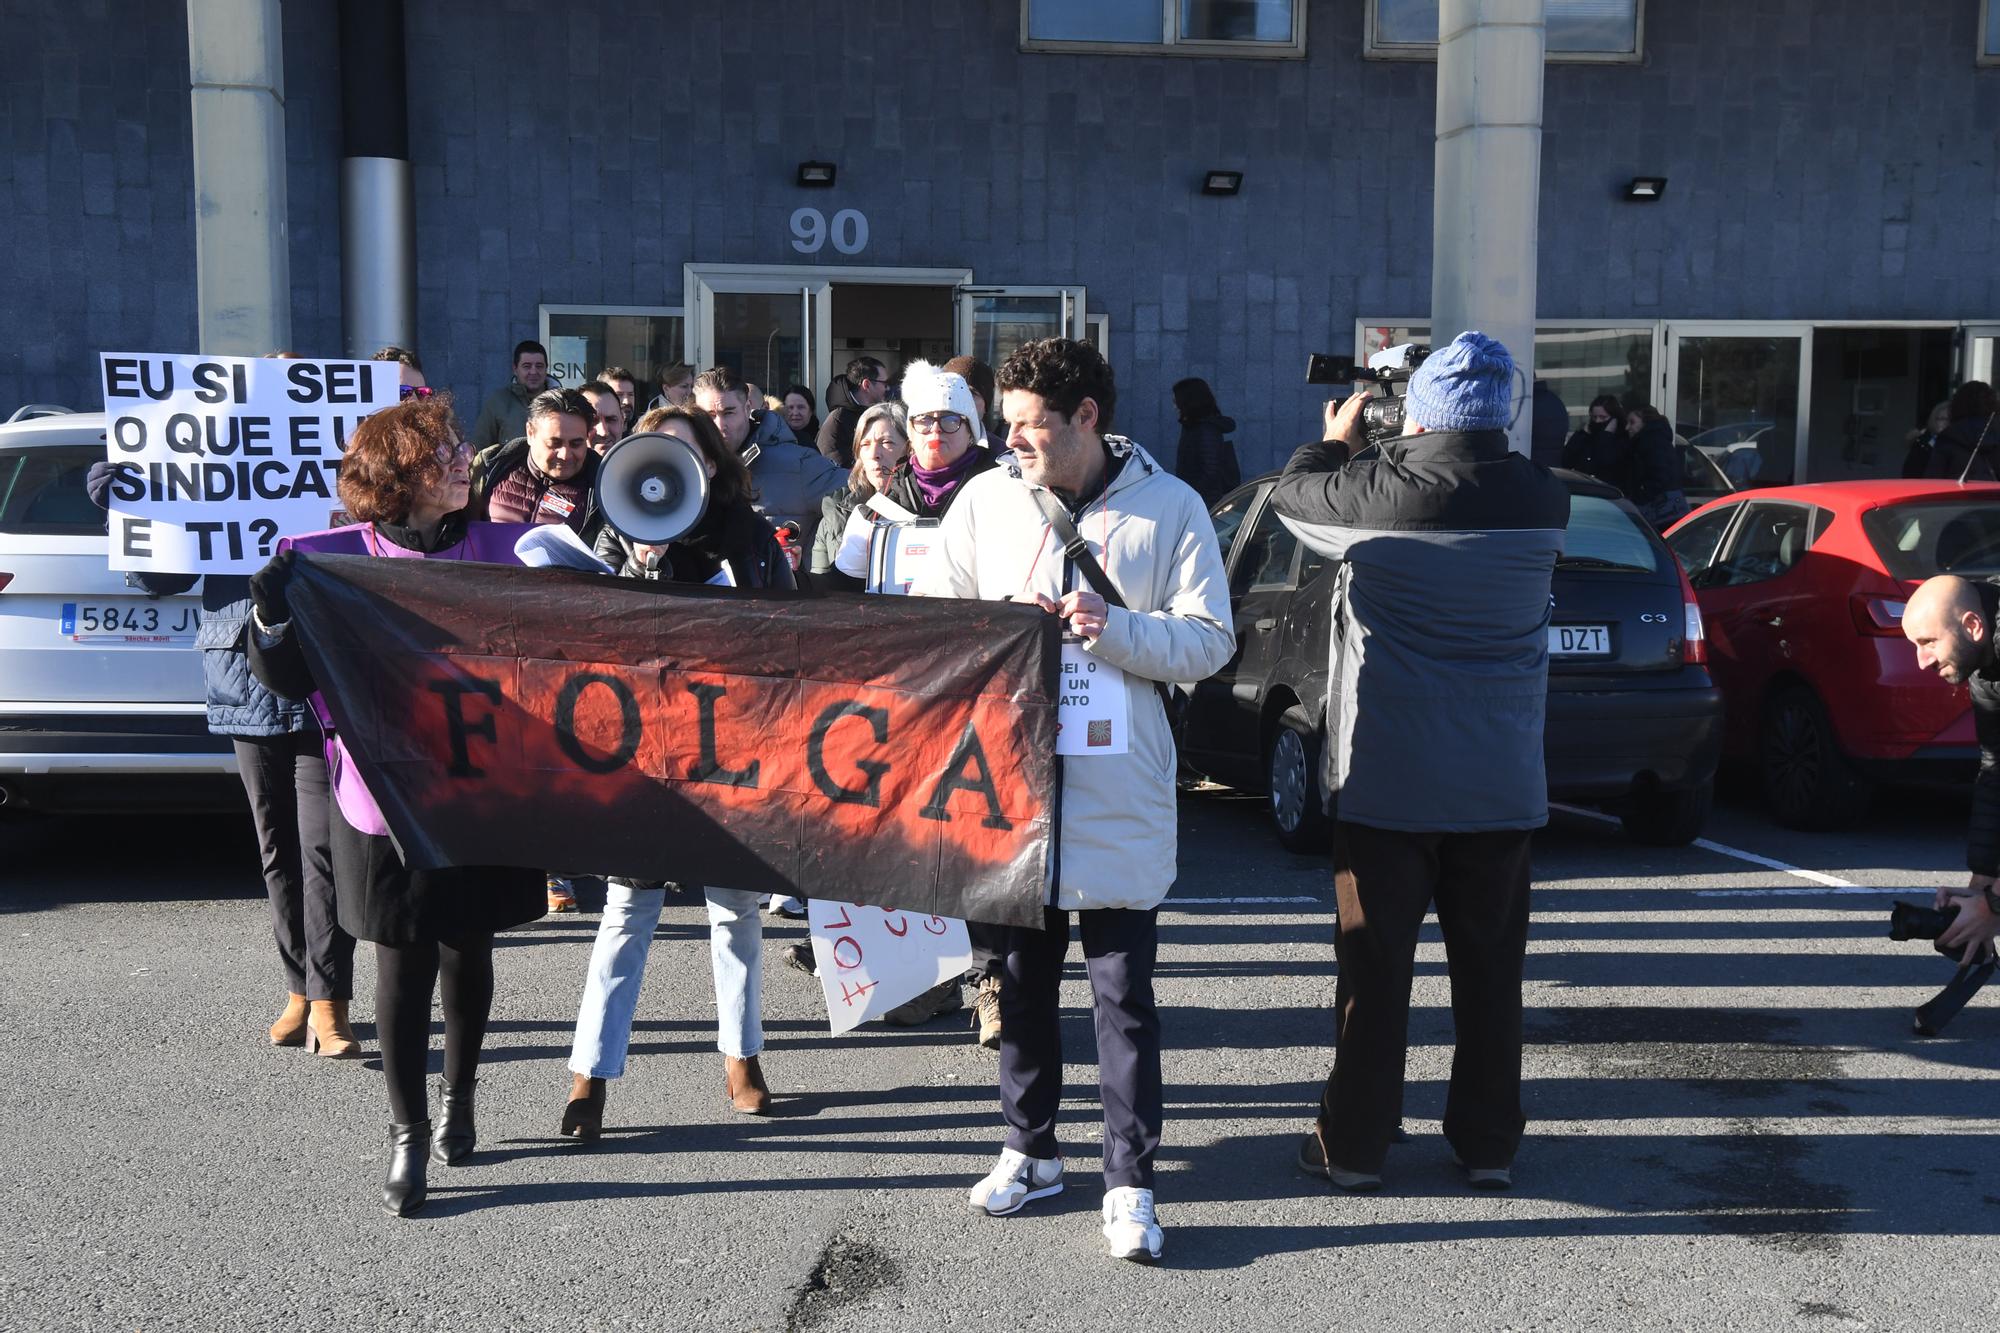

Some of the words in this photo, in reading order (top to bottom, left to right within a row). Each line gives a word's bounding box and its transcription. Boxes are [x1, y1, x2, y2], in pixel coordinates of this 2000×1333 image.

[789, 207, 869, 255] 90
[104, 358, 174, 401] EU
[192, 362, 247, 404] SI
[287, 362, 374, 404] SEI
[114, 416, 148, 453] O
[165, 413, 273, 458] QUE
[289, 416, 322, 456] E
[333, 416, 373, 453] U
[112, 459, 346, 502] SINDICAT
[123, 518, 152, 557] E
[185, 519, 279, 561] TI?
[65, 621, 71, 629] E
[82, 607, 159, 632] 5843
[1640, 613, 1667, 623] C3
[1560, 628, 1603, 651] DZT
[1060, 695, 1090, 706] ATO
[1069, 679, 1090, 690] UN
[428, 672, 1013, 832] FOLGA
